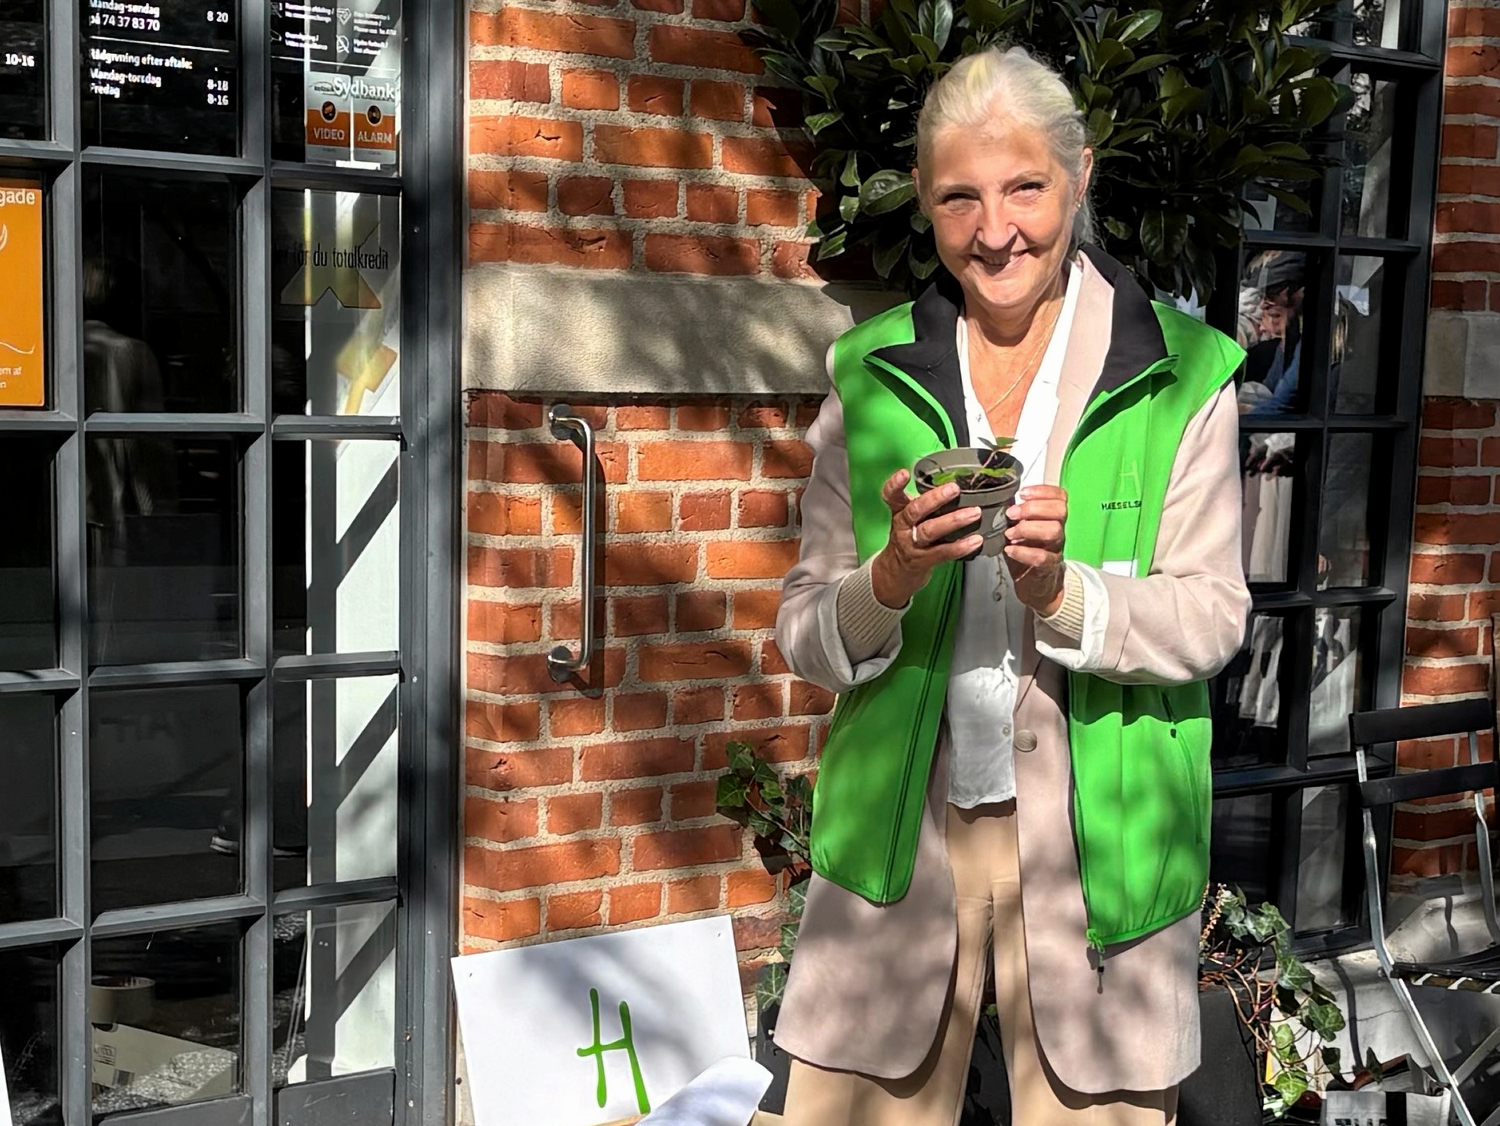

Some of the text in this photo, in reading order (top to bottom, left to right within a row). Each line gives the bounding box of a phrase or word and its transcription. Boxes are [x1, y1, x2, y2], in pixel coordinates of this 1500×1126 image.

[103, 14, 116, 26] 74
[117, 16, 130, 28] 37
[132, 17, 145, 30] 83
[147, 19, 160, 31] 70
[5, 53, 35, 67] 10-16
[333, 76, 395, 99] Sydbank
[313, 128, 392, 143] VIDEO ALARM
[313, 243, 328, 267] du
[333, 245, 389, 270] totalkredit
[577, 987, 651, 1114] H
